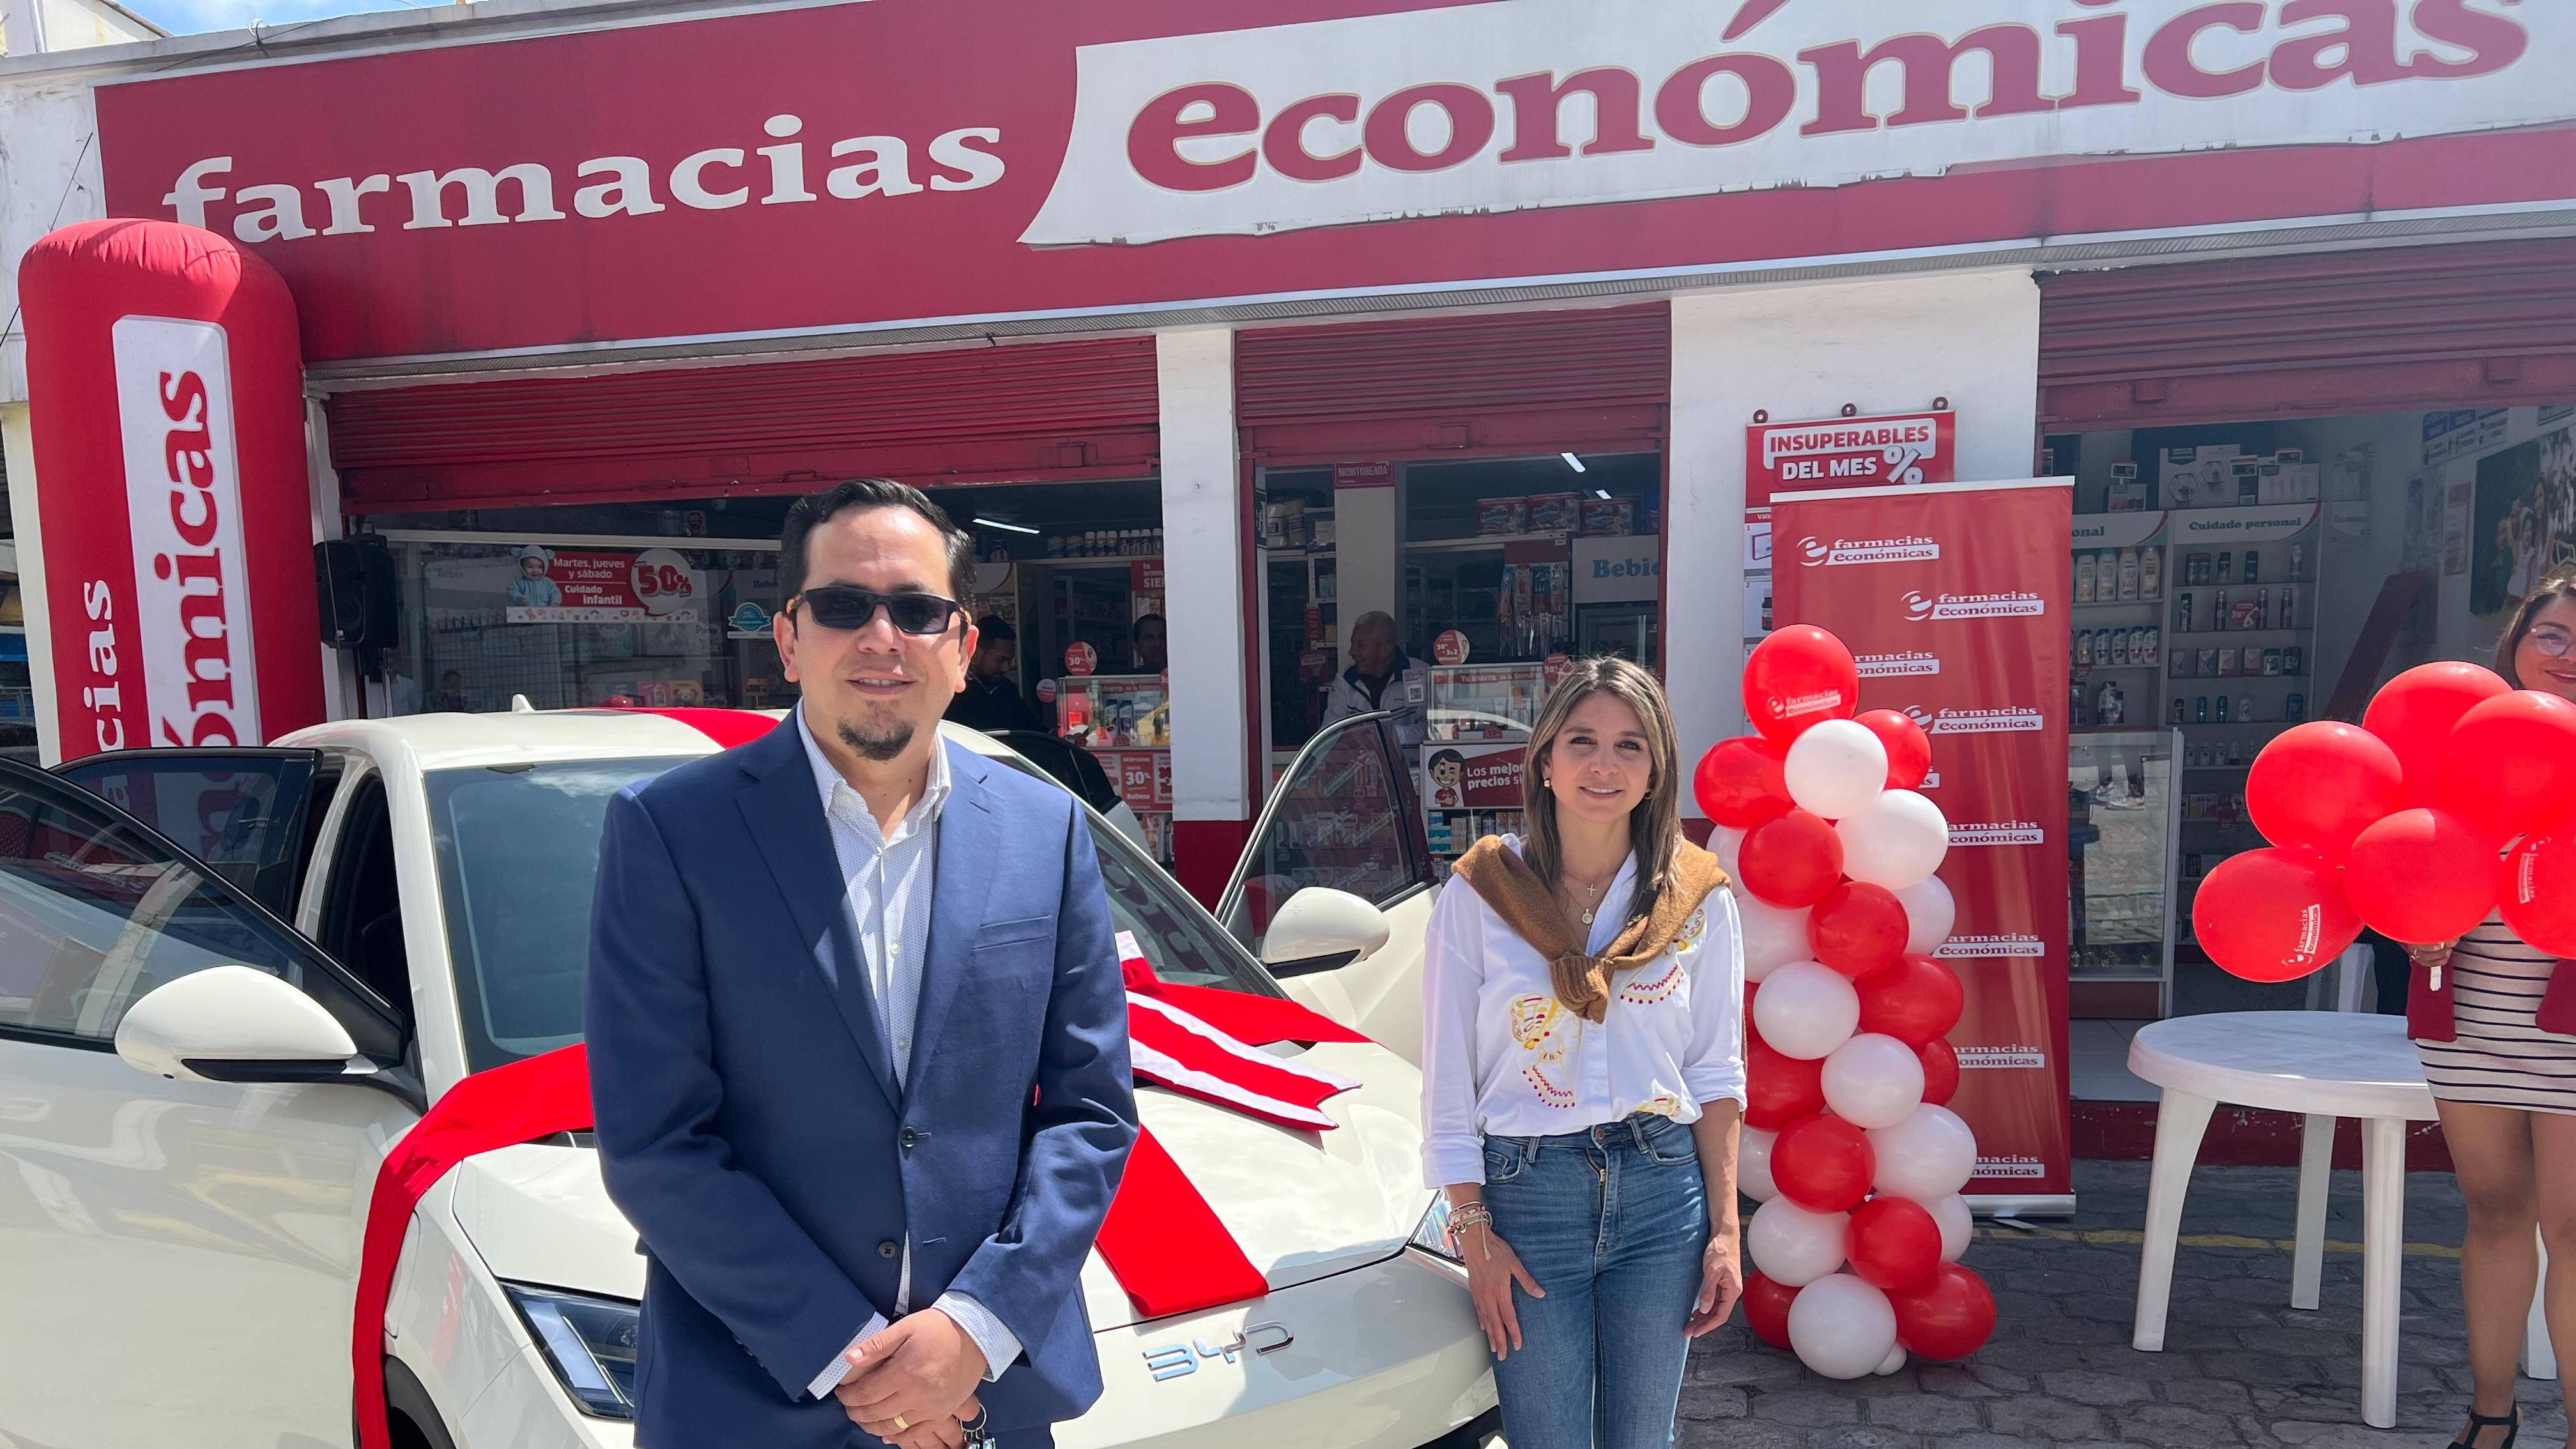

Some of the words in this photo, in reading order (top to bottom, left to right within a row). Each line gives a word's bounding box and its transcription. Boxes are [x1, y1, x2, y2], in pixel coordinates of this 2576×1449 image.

[161, 114, 1006, 242] farmacias
[1126, 0, 2530, 192] económicas
[1770, 425, 1929, 452] INSUPERABLES
[1782, 461, 1825, 480] DEL
[1829, 456, 1877, 477] MES
[2189, 519, 2242, 531] Cuidado
[2245, 517, 2301, 530] personal
[1834, 535, 1933, 549] farmacias
[1834, 548, 1933, 562] económicas
[553, 558, 592, 569] Martes,
[593, 559, 625, 569] jueves
[569, 570, 574, 579] y
[577, 568, 613, 579] sábado
[638, 564, 693, 595] 50%
[565, 585, 602, 594] Cuidado
[583, 594, 623, 605] infantil
[1938, 590, 2038, 603] farmacias
[1938, 603, 2037, 616] económicas
[1786, 689, 1838, 705] farmacias
[1788, 698, 1838, 714] económicas
[1938, 706, 2037, 718] farmacias
[1938, 718, 2036, 730] económicas
[1124, 770, 1151, 786] 30%
[1467, 767, 1487, 778] Los
[1468, 776, 1510, 791] precios
[1947, 820, 2038, 831] armacias
[1948, 832, 2037, 843] conómicas
[1940, 944, 2038, 955] económicas
[1142, 1319, 1294, 1383] BYD
